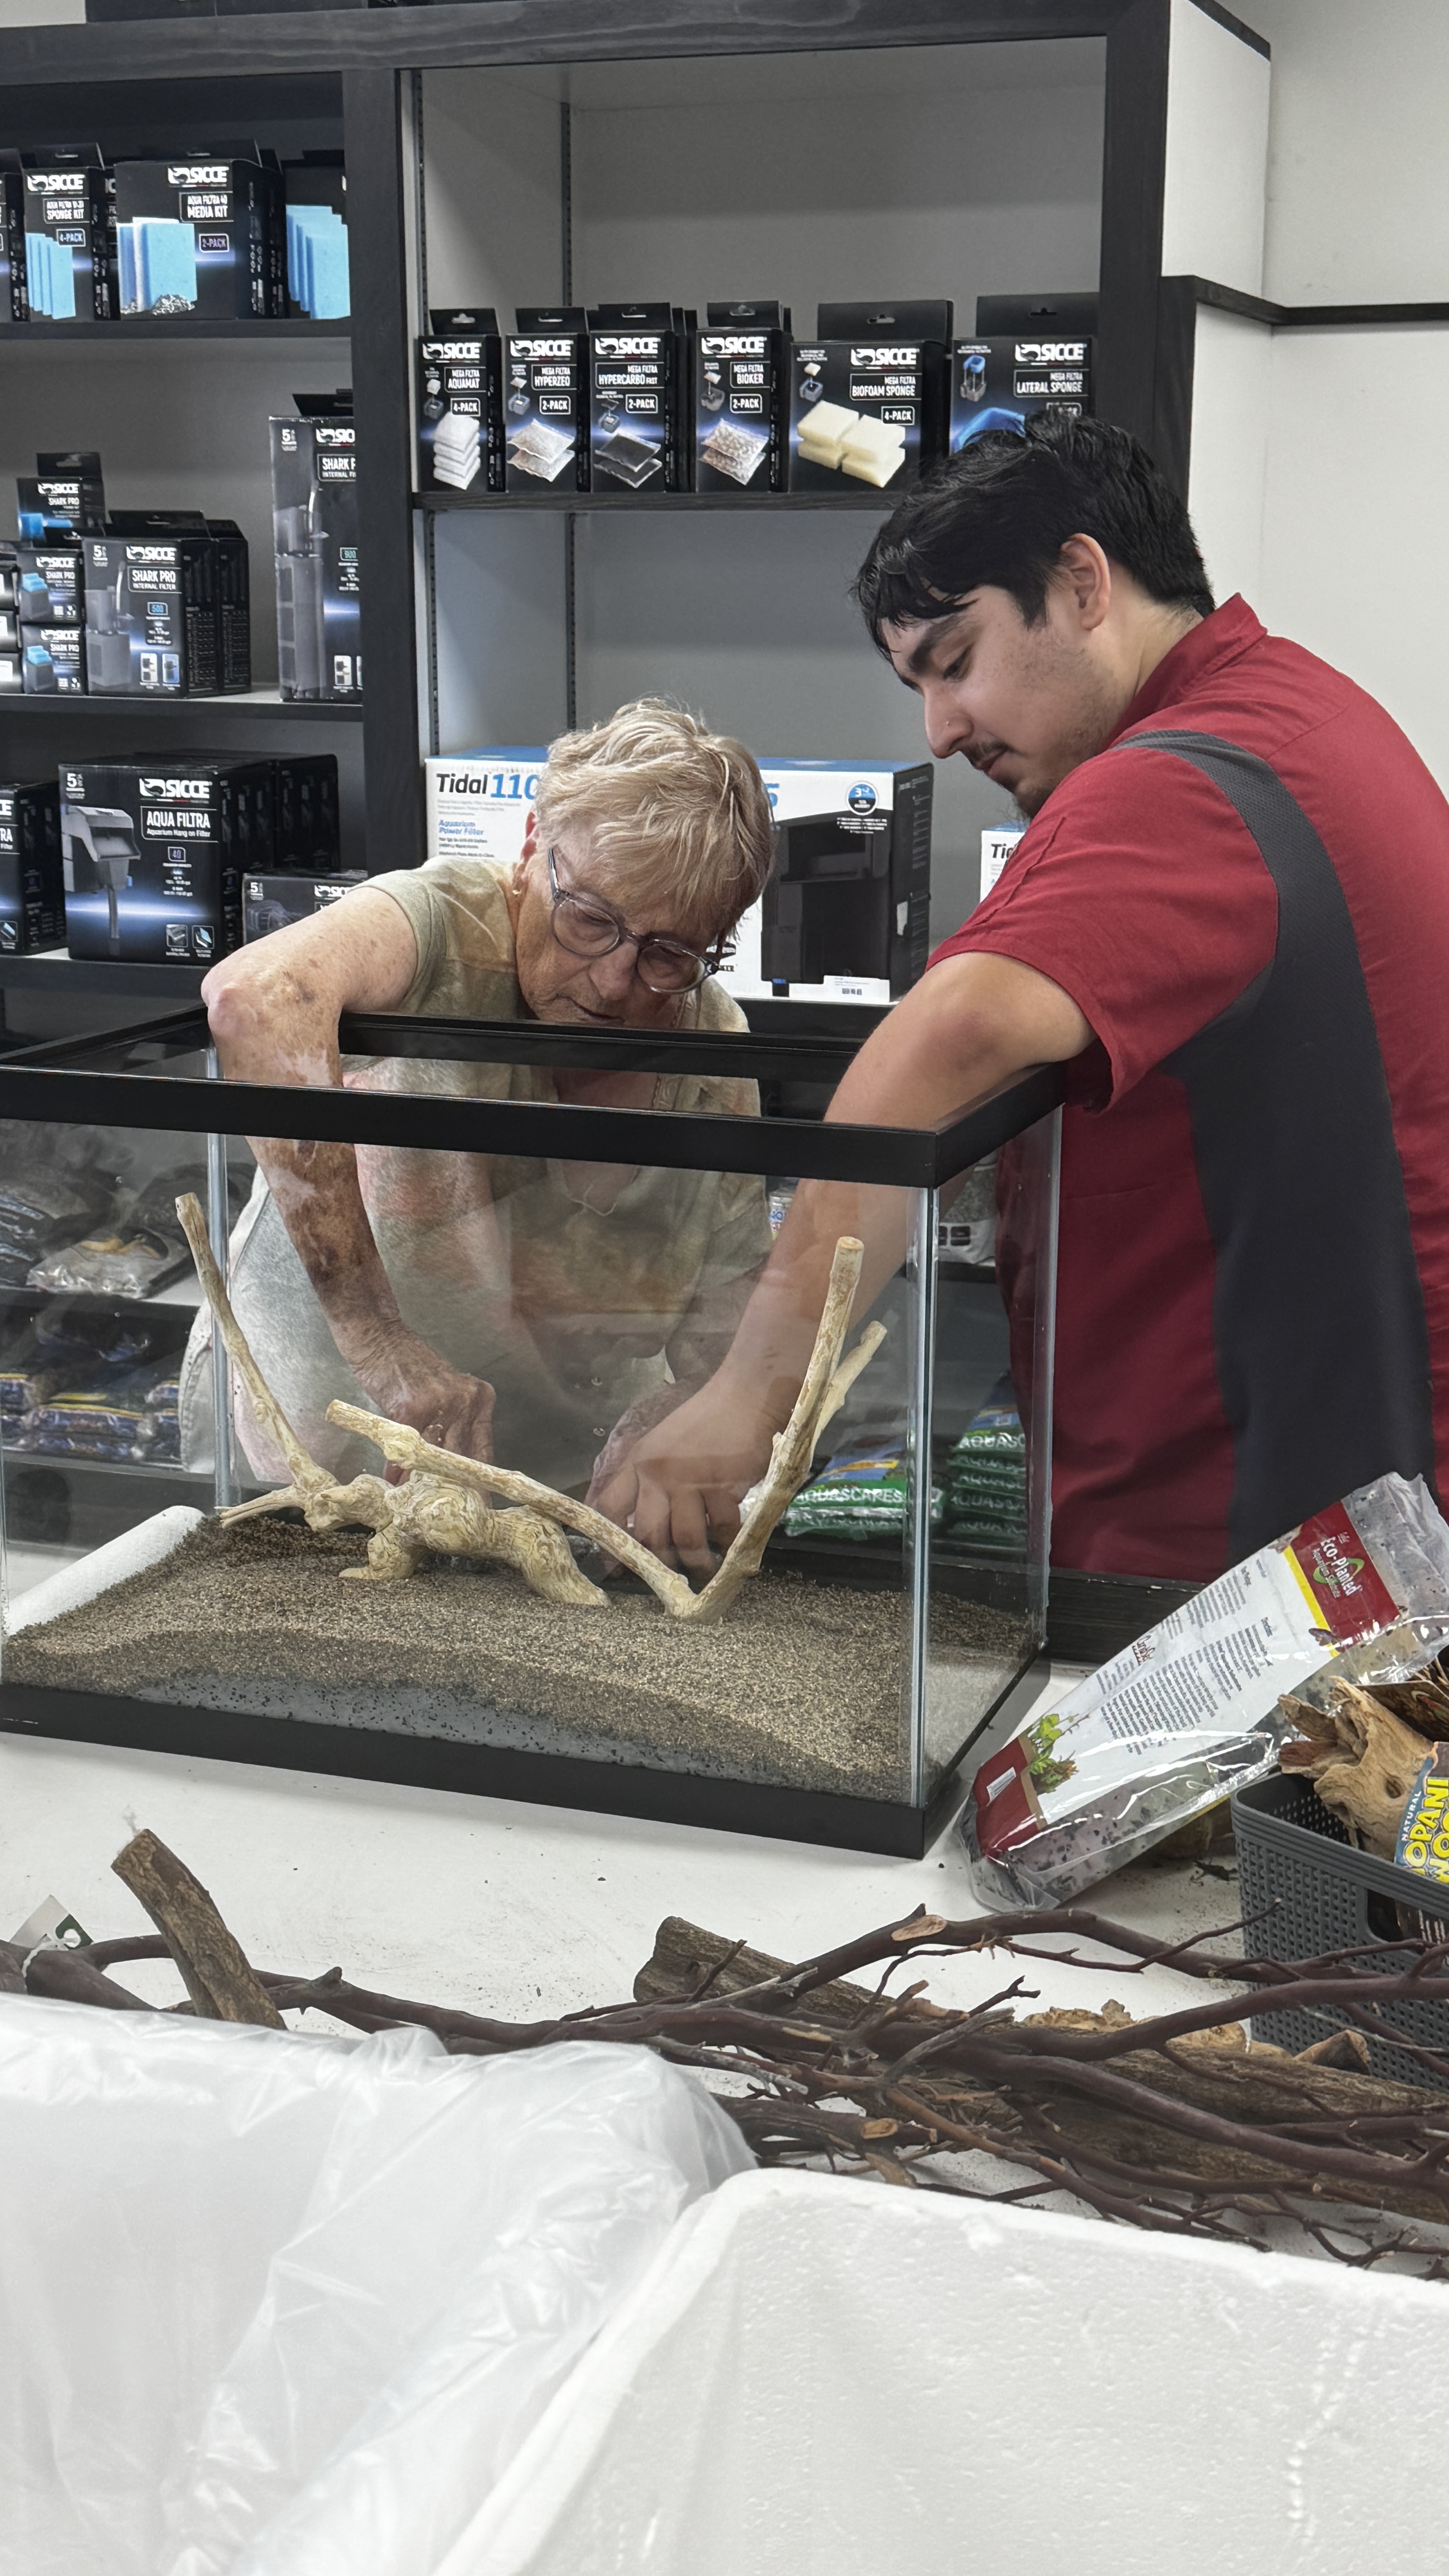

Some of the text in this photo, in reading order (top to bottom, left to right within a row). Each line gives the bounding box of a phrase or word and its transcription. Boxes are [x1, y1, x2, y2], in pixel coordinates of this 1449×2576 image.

[191, 166, 229, 183] SICCE
[48, 175, 85, 190] SICCE
[46, 209, 84, 220] SPONGE KIT
[187, 205, 228, 218] MEDIA KIT
[60, 233, 83, 243] 4-PACK
[202, 238, 226, 248] 2-PACK
[533, 340, 571, 356] SICCE
[619, 337, 658, 354] SICCE
[725, 336, 764, 354] SICCE
[444, 343, 480, 359] SICCE
[876, 348, 917, 365] SICCE
[1042, 343, 1084, 361] SICCE
[452, 369, 480, 377] MEGA FILTRA
[542, 367, 571, 375] MEGA FILTRA
[627, 365, 658, 373] MEGA FILTRA
[734, 364, 764, 373] MEGA FILTRA
[534, 376, 571, 387] HYPERZEO
[598, 374, 645, 385] HYPERCARBO
[736, 373, 764, 384] BIOKER
[884, 376, 916, 385] MEGA FILTRA
[1050, 372, 1083, 381] MEGA FILTRA
[448, 378, 480, 389] AQUAMAT
[1017, 382, 1083, 393] LATERAL SPONGE
[852, 385, 915, 396] BIOFOAM SPONGE
[453, 402, 478, 412] 4-PACK
[542, 400, 568, 410] 2-PACK
[628, 398, 655, 409] 2-PACK
[733, 398, 759, 409] 2-PACK
[884, 410, 912, 421] 4-PACK
[282, 428, 291, 442] 5
[322, 457, 350, 470] SHARK
[52, 483, 80, 494] SICCE
[48, 497, 80, 506] SHARK PRO
[93, 545, 102, 558] 5
[144, 546, 176, 561] SICCE
[51, 557, 75, 568] SICCE
[46, 571, 75, 580] SHARK PRO
[132, 570, 176, 583] SHARK PRO
[55, 630, 79, 641] SICCE
[50, 644, 80, 652] SHARK PRO
[67, 773, 77, 787] 5
[436, 773, 488, 794] Tidal
[166, 779, 210, 799] SICCE
[147, 811, 211, 828] AQUA FILTRA
[147, 828, 173, 837] Aquarium
[174, 829, 188, 838] Hang
[172, 849, 181, 859] 40
[250, 882, 258, 893] 5
[959, 1433, 1026, 1449] AQUASC
[1320, 1536, 1362, 1596] Eco-Planted
[1401, 1790, 1422, 1842] NATURAL
